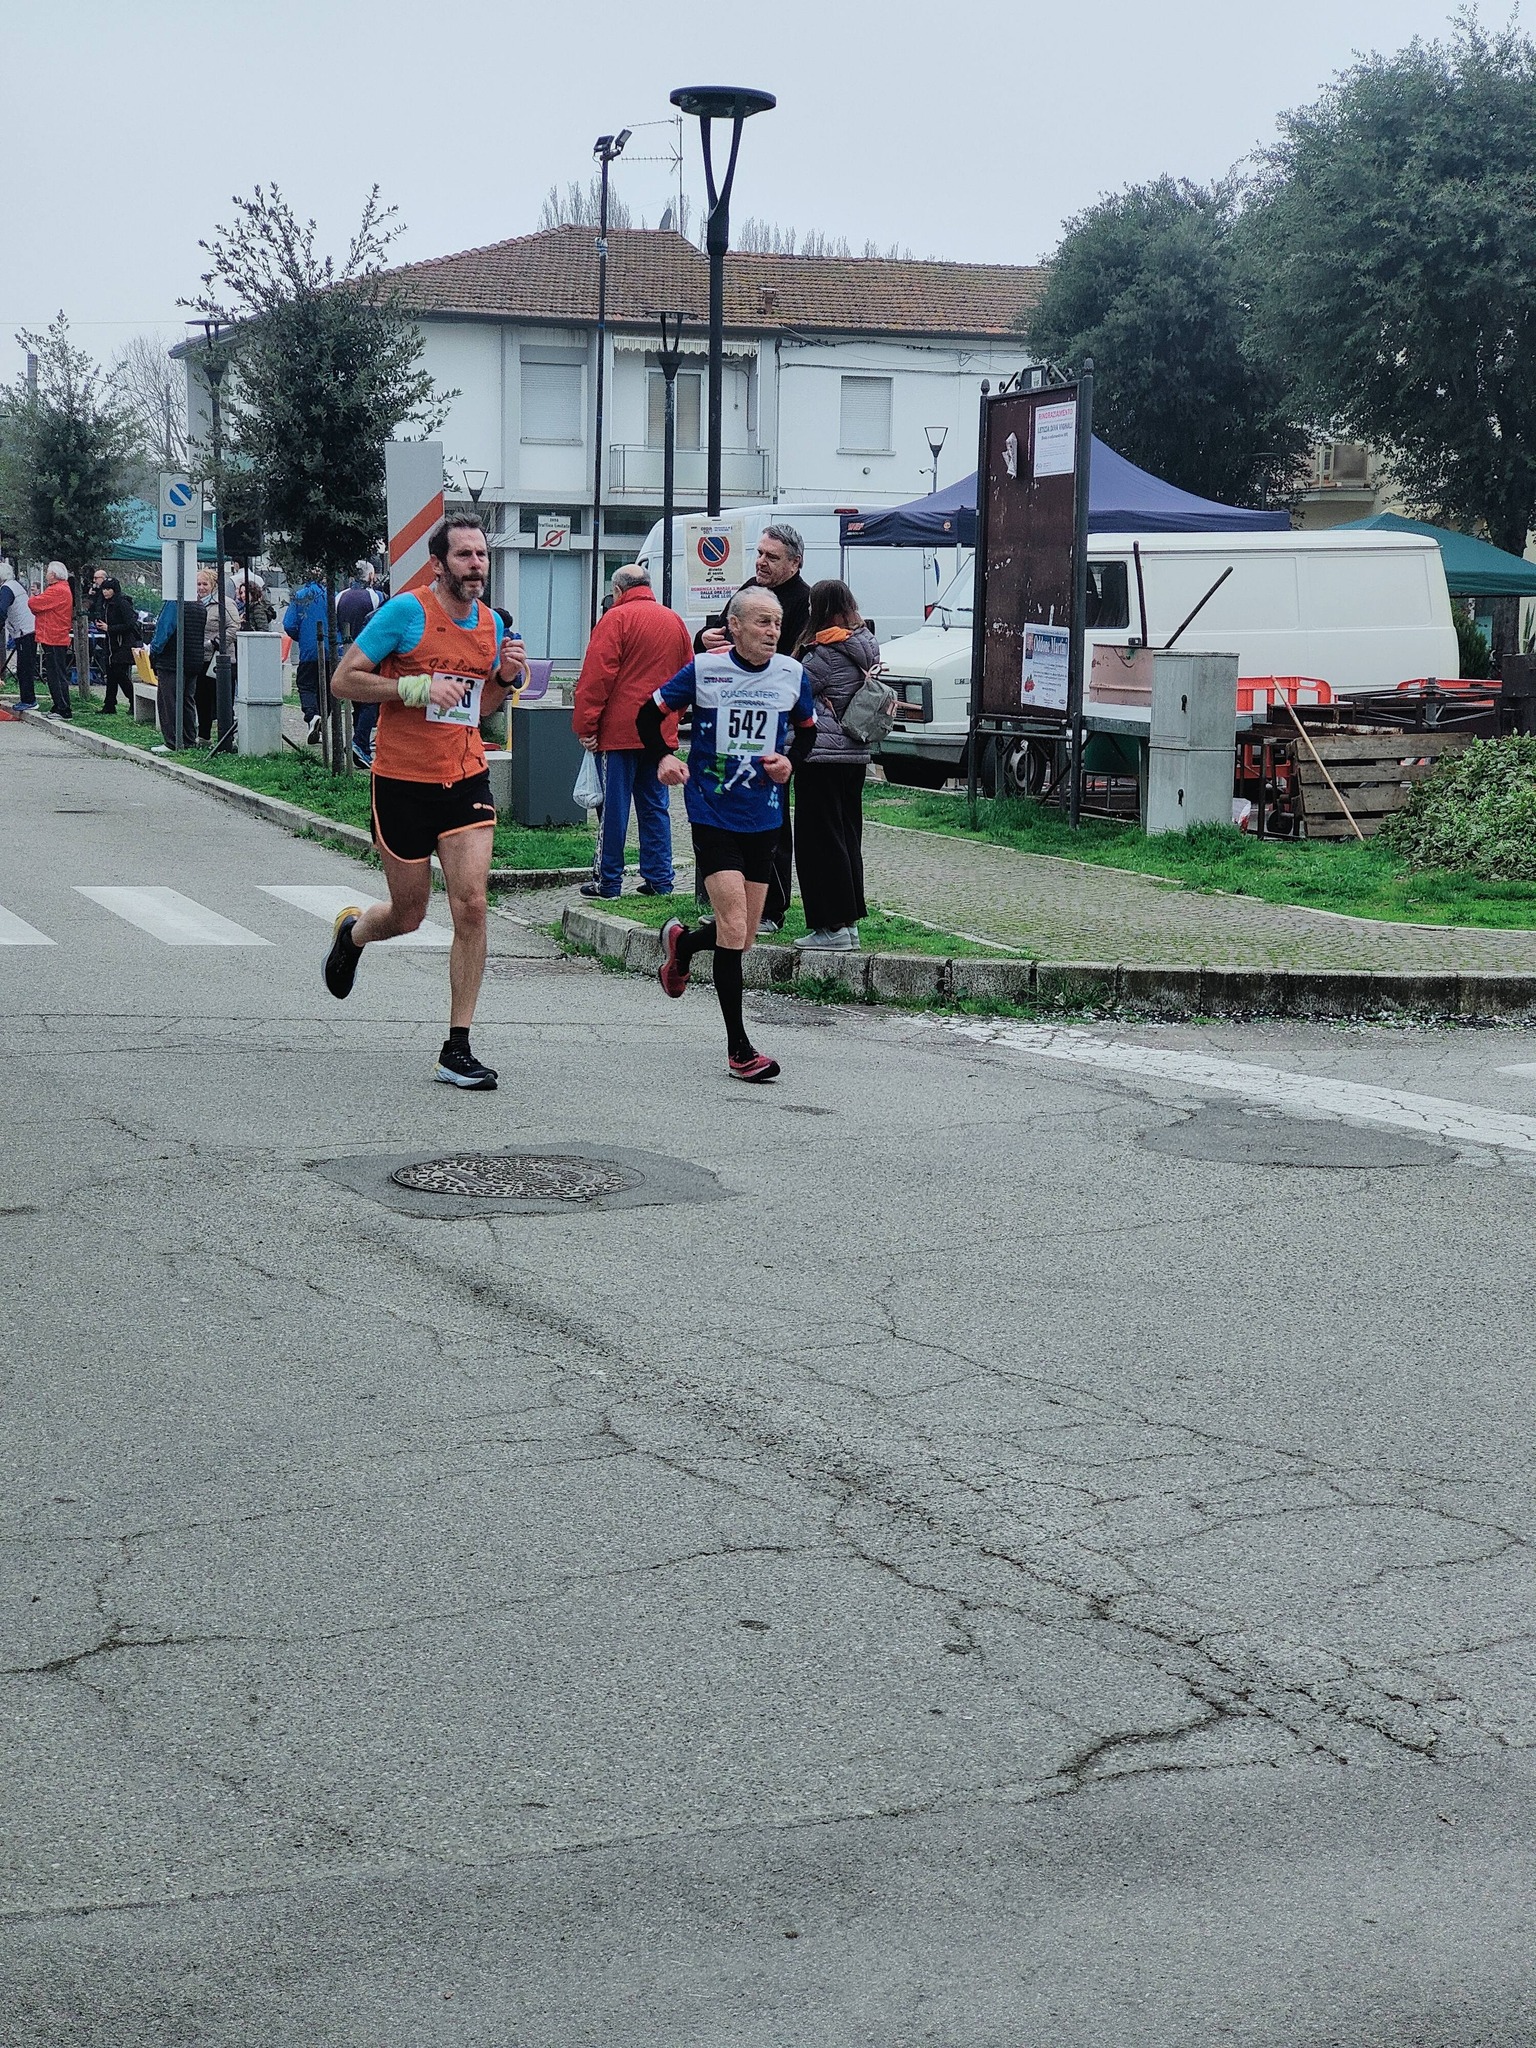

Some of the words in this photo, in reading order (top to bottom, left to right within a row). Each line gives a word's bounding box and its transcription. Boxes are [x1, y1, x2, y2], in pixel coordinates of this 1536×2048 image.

[1038, 408, 1073, 419] RINGRAZIAMENTO
[165, 515, 174, 525] P
[720, 690, 779, 699] QUADRILATERO
[729, 709, 767, 740] 542
